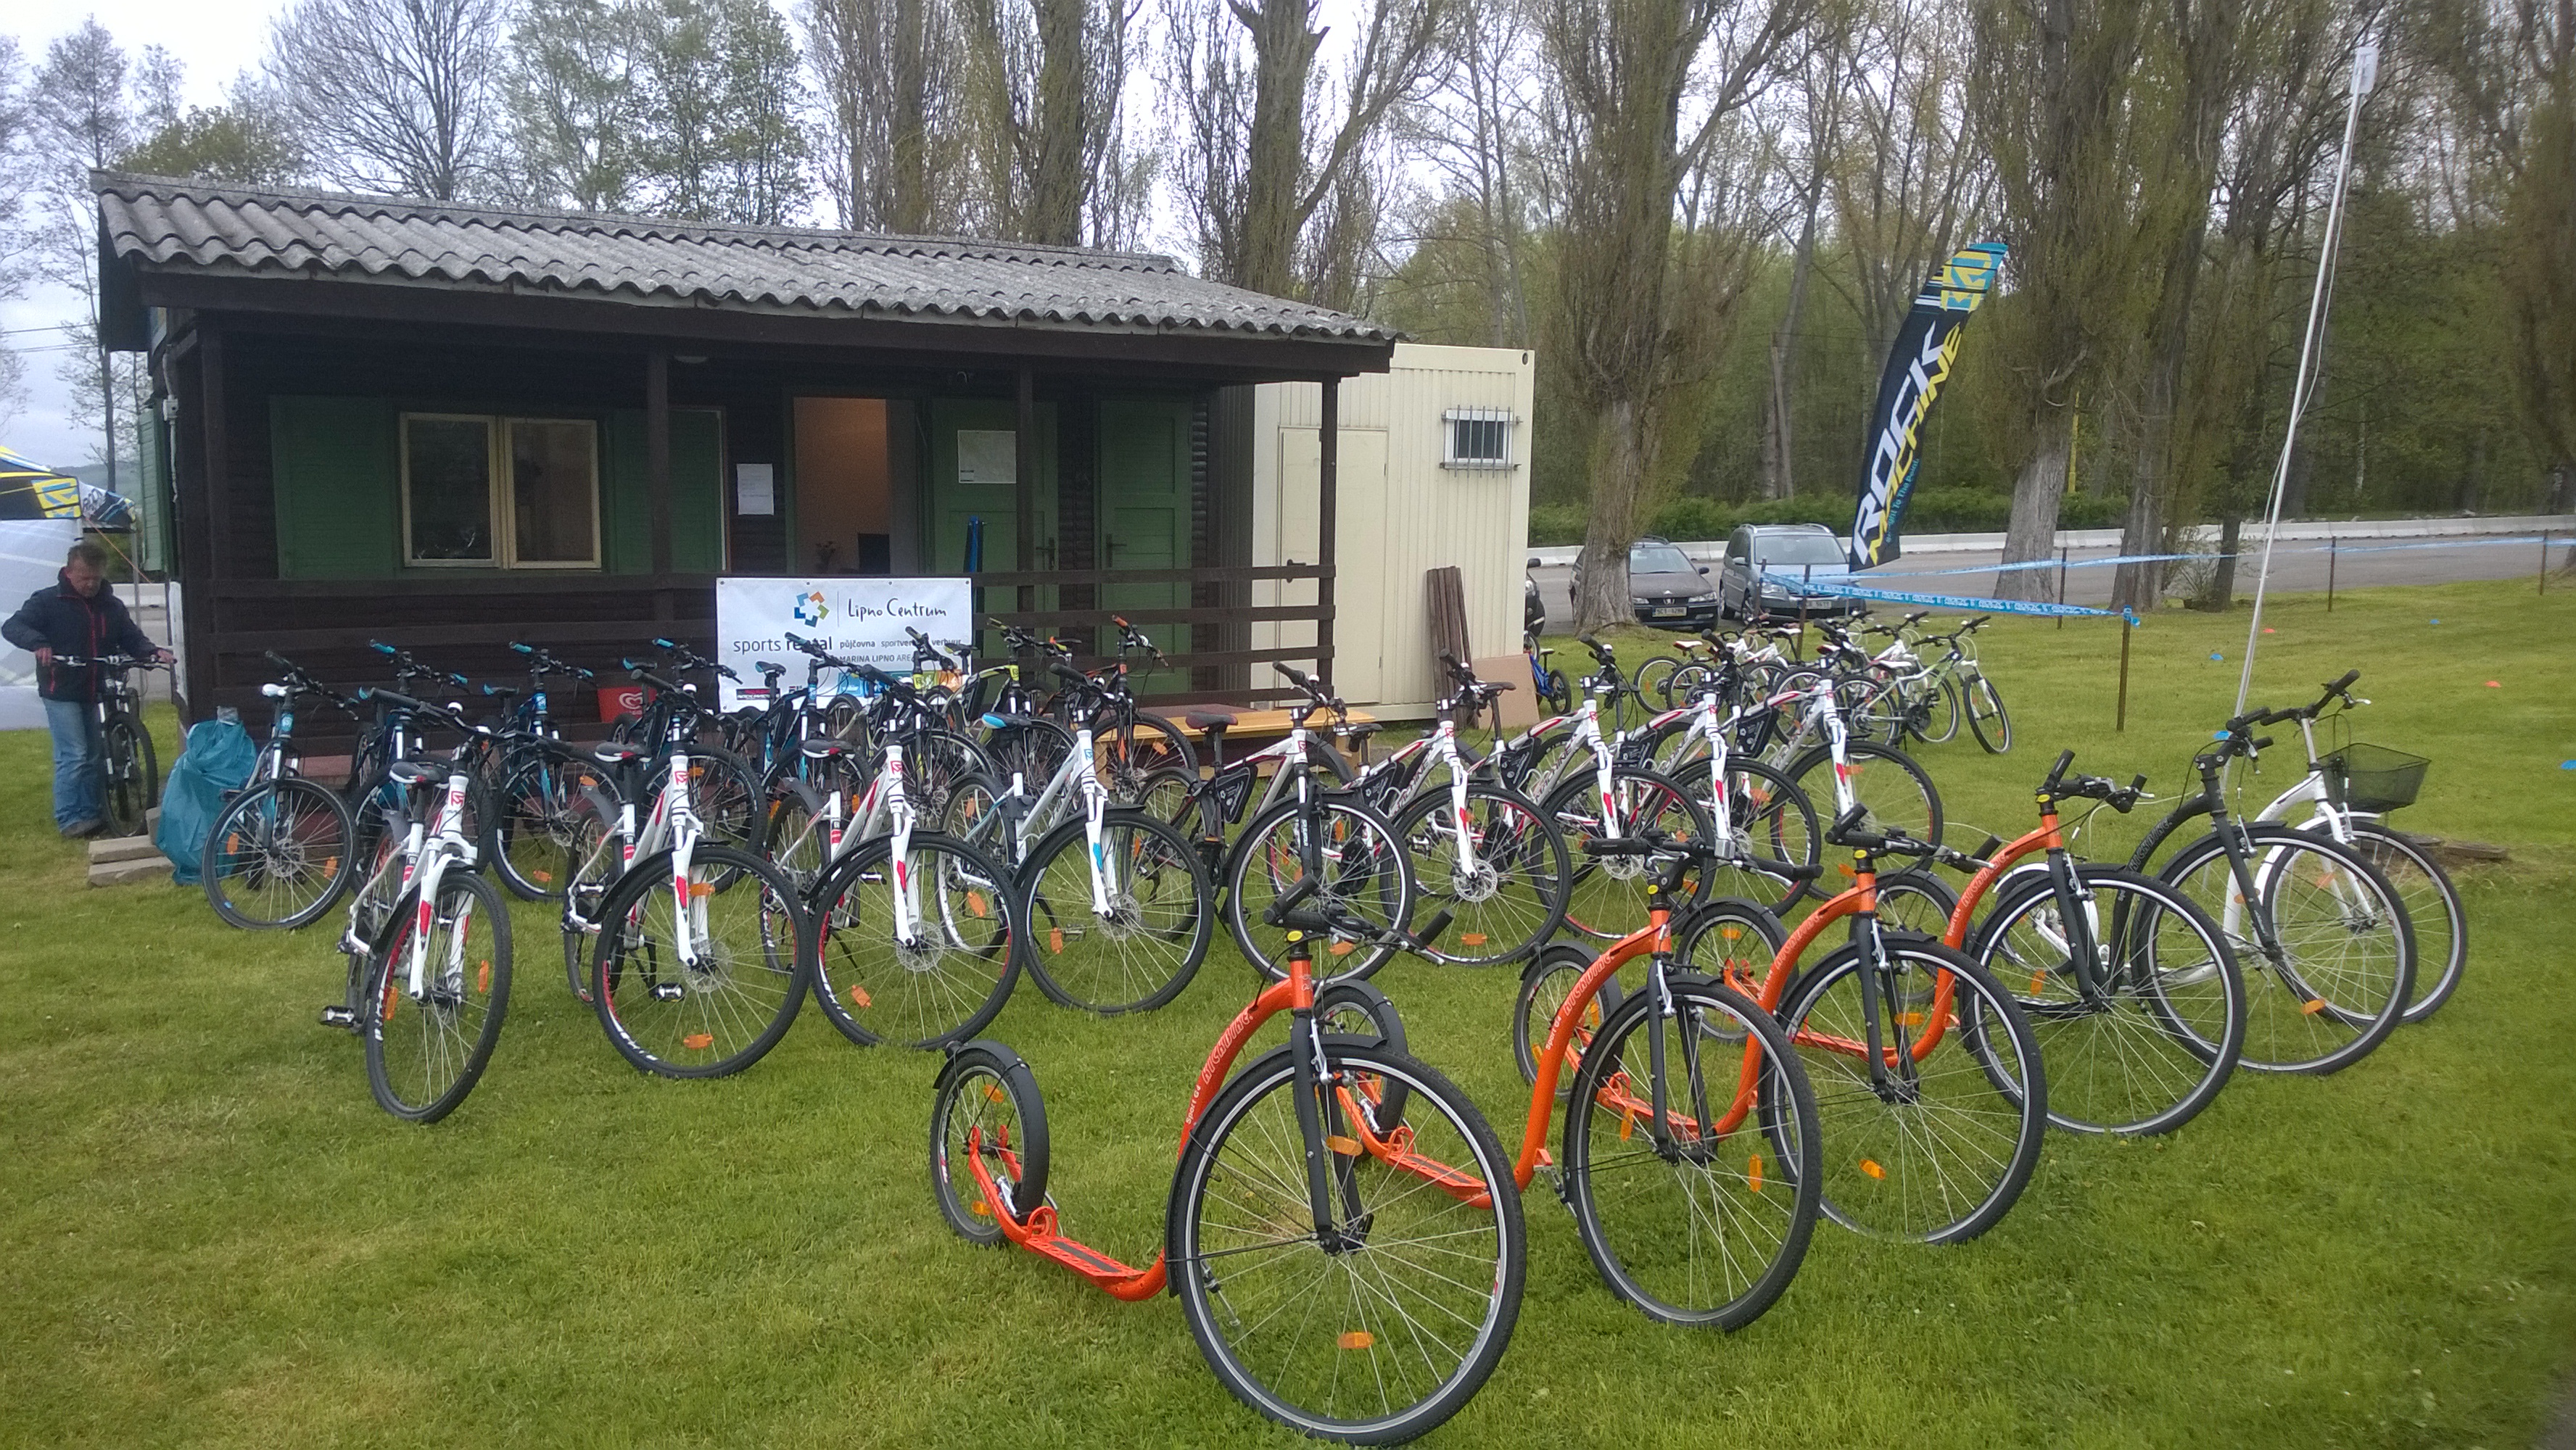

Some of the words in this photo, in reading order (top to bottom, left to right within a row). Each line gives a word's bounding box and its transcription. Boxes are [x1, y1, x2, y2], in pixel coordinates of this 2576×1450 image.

[1853, 320, 1945, 566] ROCK
[1868, 321, 1962, 566] MACHINE
[848, 597, 883, 623] Lipno
[886, 597, 947, 617] Centrum
[732, 639, 782, 655] sports
[786, 636, 833, 652] real
[839, 638, 876, 650] půjčovna
[871, 655, 895, 663] LIPNO
[896, 655, 913, 663] ARE
[1545, 1029, 1558, 1051] Sport
[1185, 1100, 1198, 1124] Sport
[1193, 1084, 1202, 1098] G4
